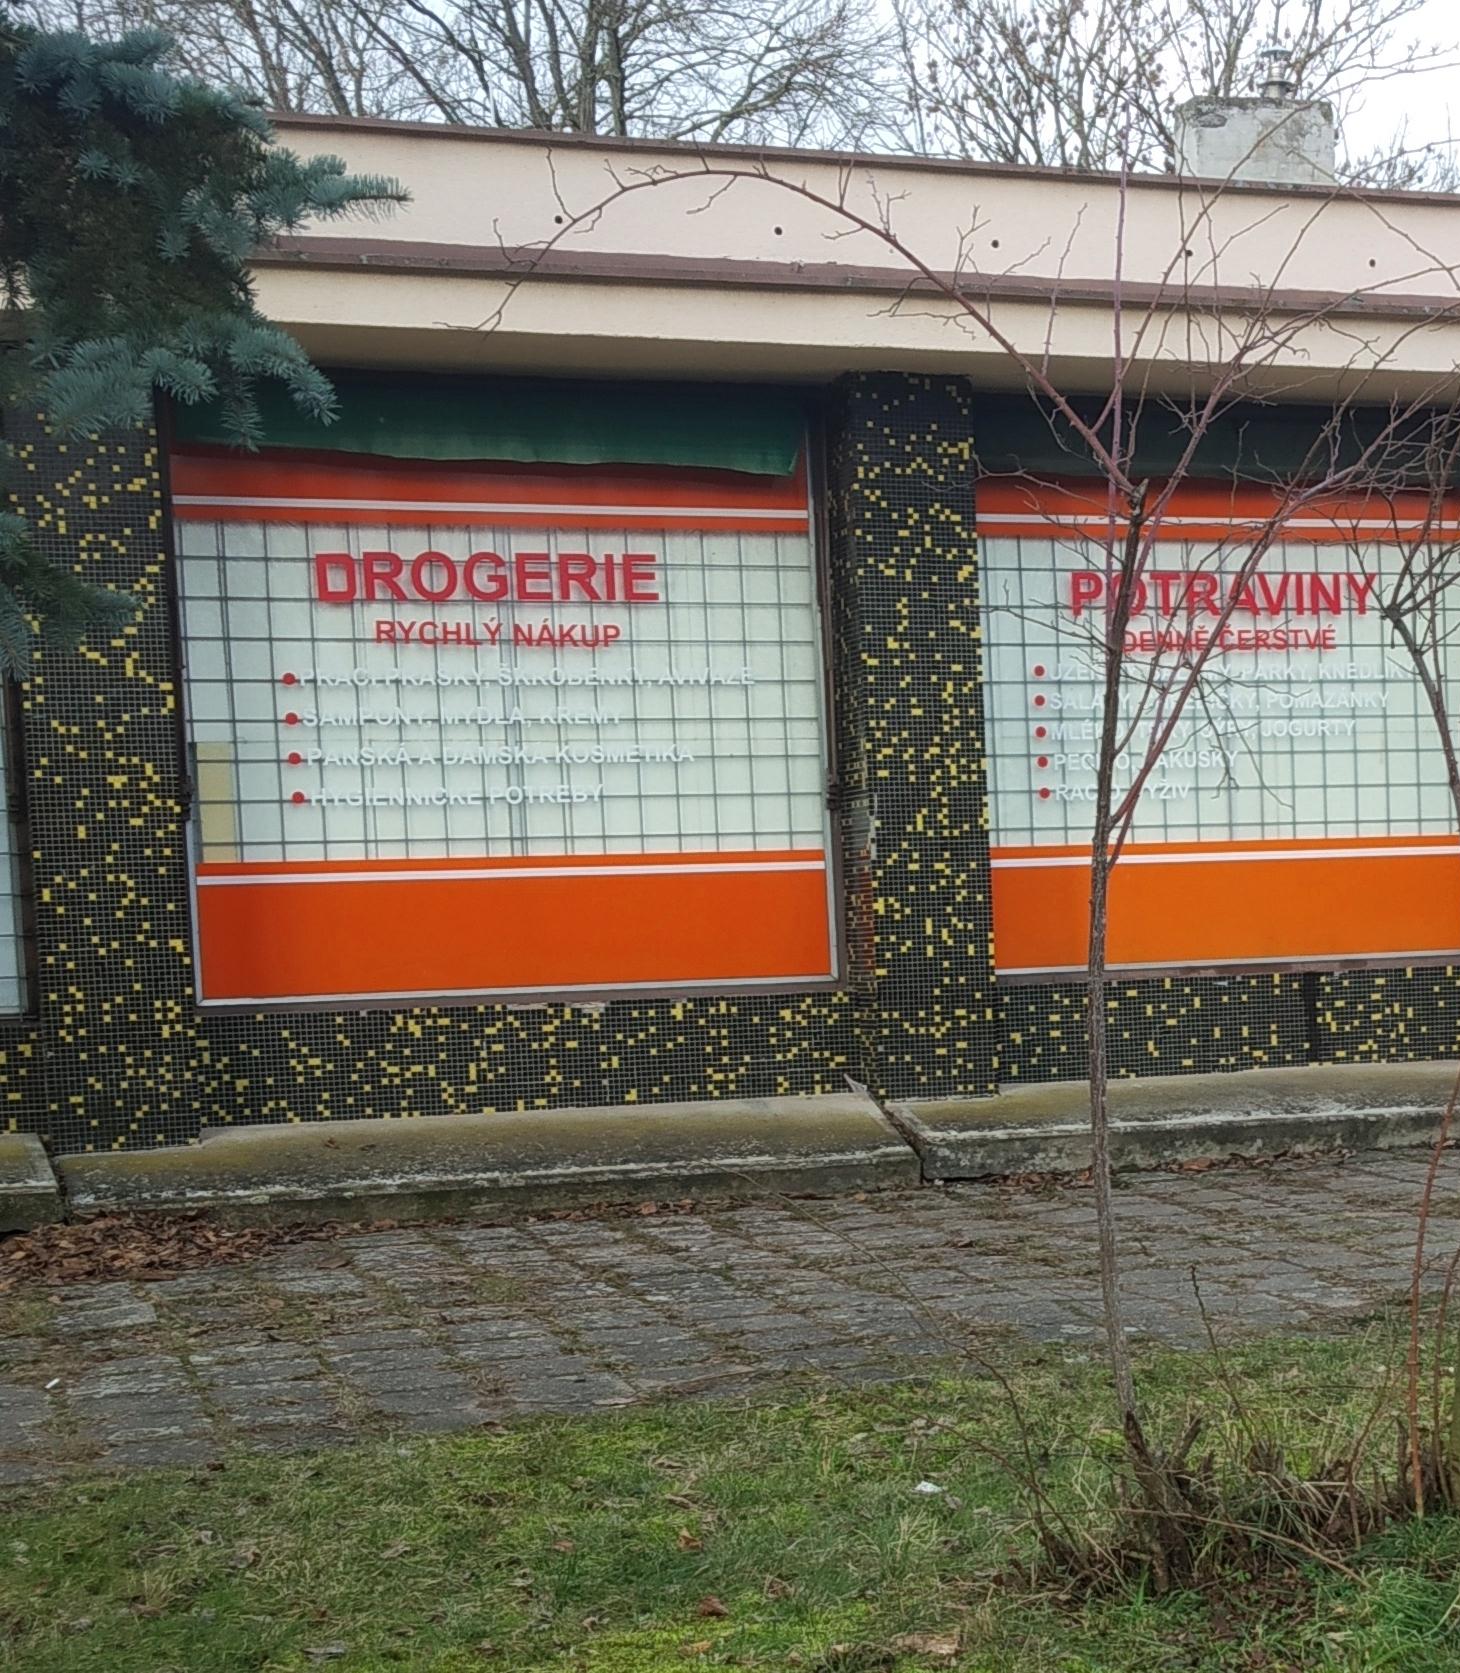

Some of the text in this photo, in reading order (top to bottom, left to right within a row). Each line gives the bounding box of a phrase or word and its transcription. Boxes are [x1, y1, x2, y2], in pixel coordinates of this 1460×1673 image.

[315, 551, 660, 603] DROGERIE
[1070, 571, 1378, 618] POTRAVINY
[375, 616, 621, 648] RYCHLÝ NÁKUP
[1218, 623, 1337, 652] ČERSTVÉ
[1262, 719, 1357, 738] JOGURTY
[418, 747, 437, 765] A
[1148, 749, 1239, 769] AKUSKY
